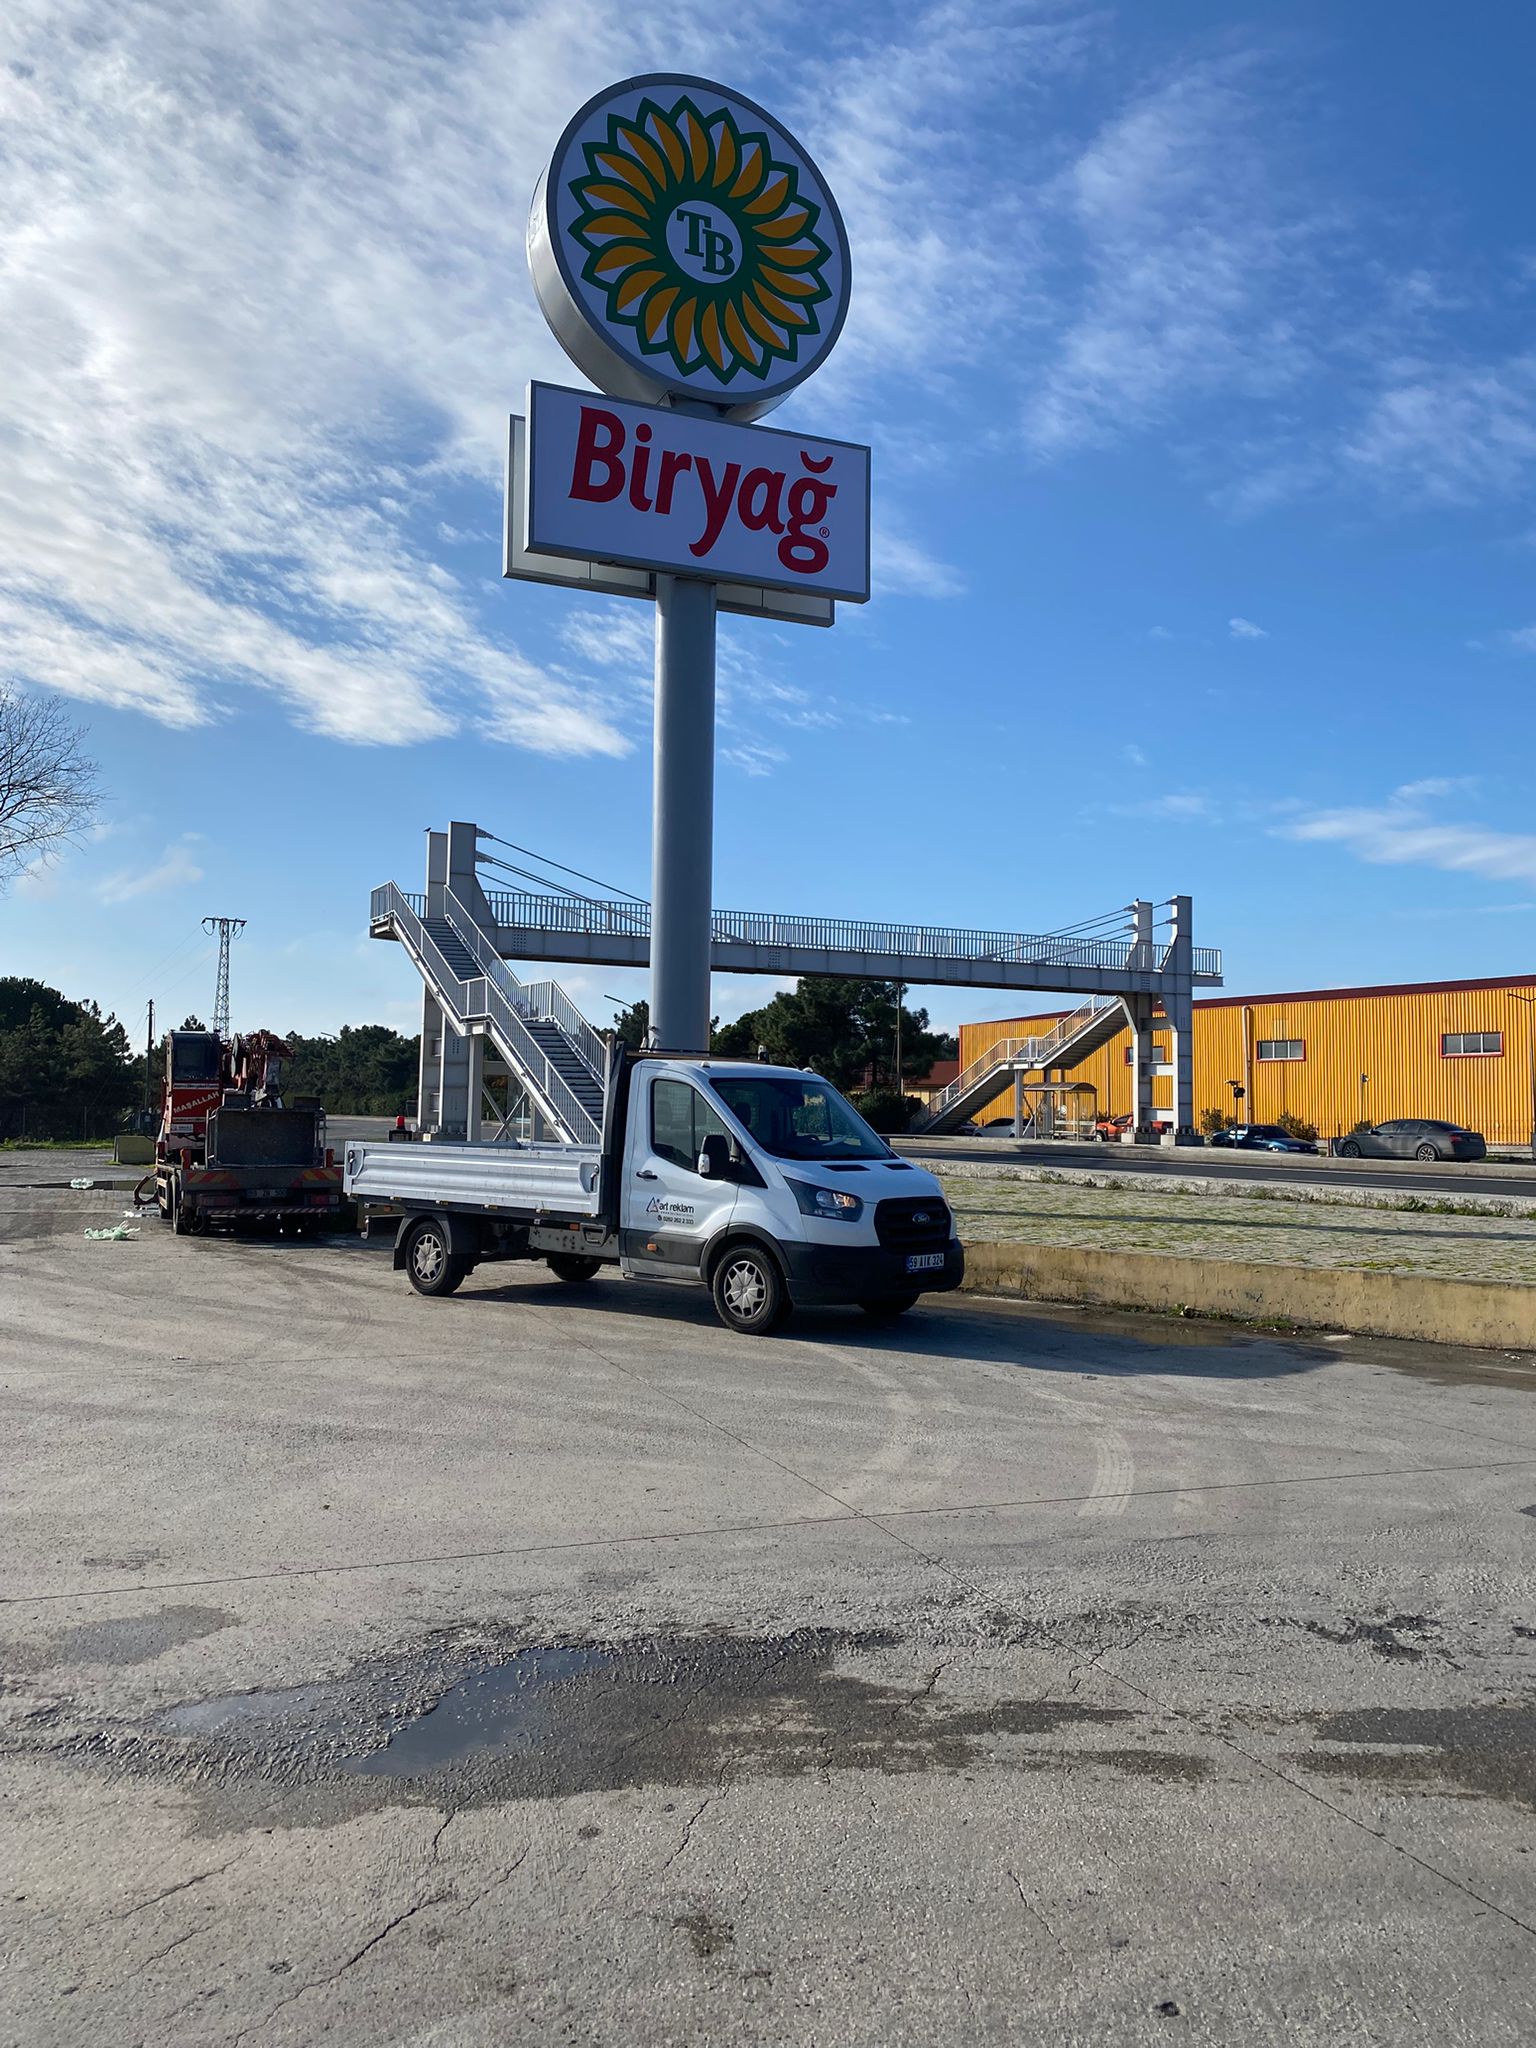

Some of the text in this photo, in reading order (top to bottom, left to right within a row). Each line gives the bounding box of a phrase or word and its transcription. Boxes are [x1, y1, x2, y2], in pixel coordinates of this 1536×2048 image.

[677, 208, 736, 275] TB
[568, 406, 838, 574] Biryağ
[670, 1203, 694, 1213] reklam
